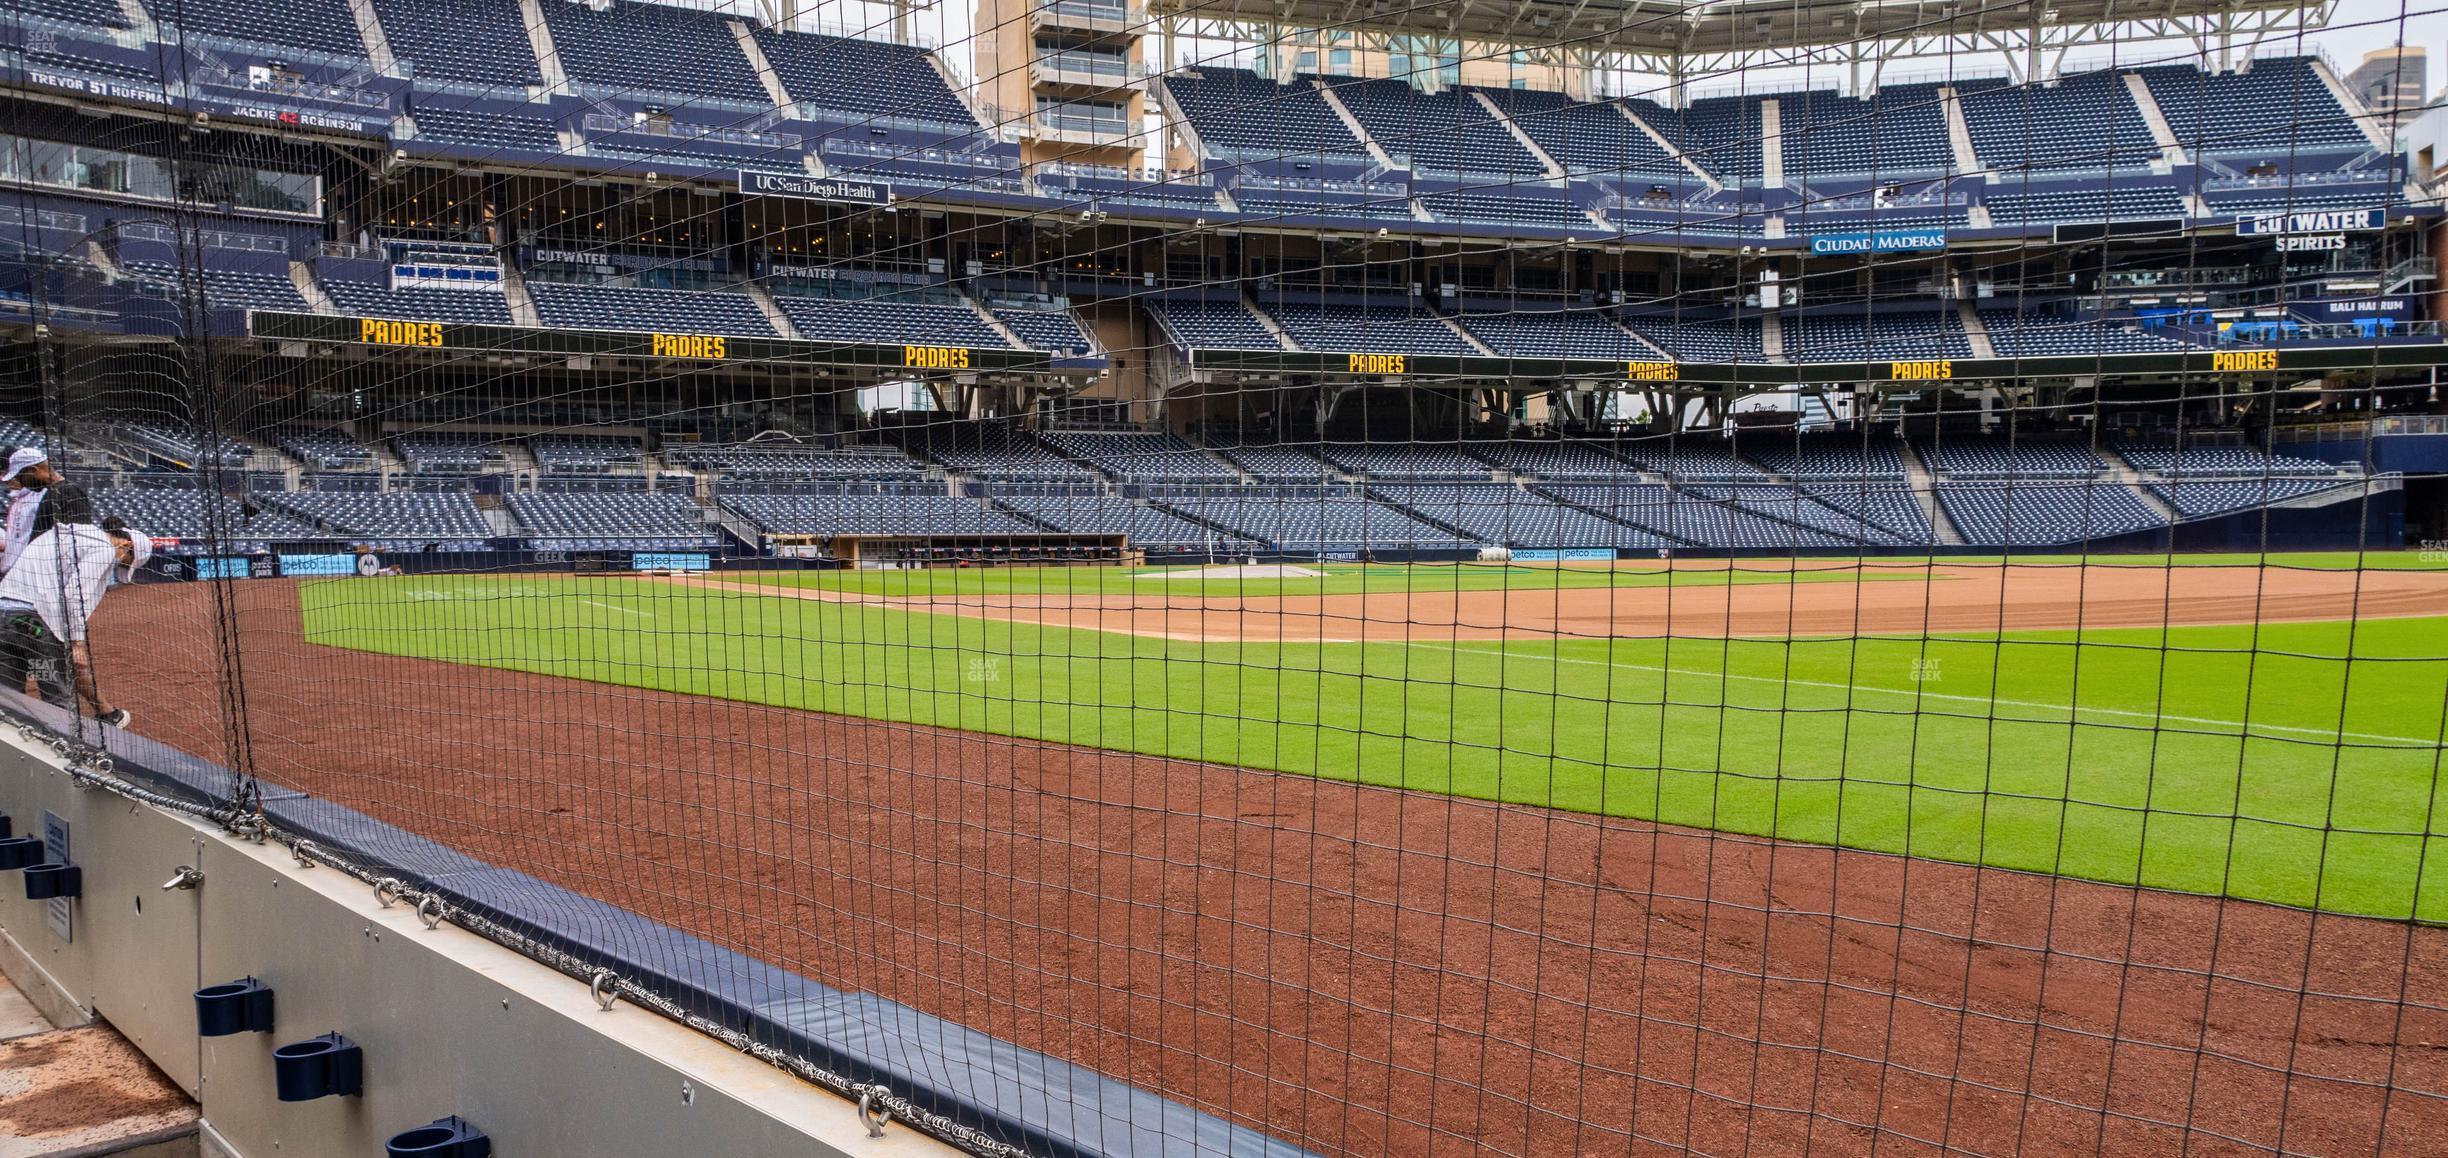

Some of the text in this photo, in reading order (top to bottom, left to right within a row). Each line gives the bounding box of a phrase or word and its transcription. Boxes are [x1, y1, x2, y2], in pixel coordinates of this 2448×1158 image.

[29, 72, 173, 105] TREVOR 51 HOFFMAN
[232, 106, 362, 132] JACKIE 42 ROBINSON
[756, 175, 876, 199] UC San Diego Health
[2253, 210, 2369, 233] CUTWATER
[1815, 235, 1944, 252] CIUDAD MADERAS
[2276, 235, 2346, 251] SPIRITS
[537, 249, 608, 265] CUTWATER
[772, 265, 836, 280] CUTWATER
[2330, 300, 2403, 312] BALI HAI RUM
[362, 319, 443, 346] PADRES
[653, 334, 725, 358] PADRES
[905, 346, 968, 368] PADRES
[1349, 353, 1404, 374] PADRES
[2213, 351, 2278, 371] PADRES
[1628, 361, 1678, 380] PADRES
[1892, 361, 1951, 380] PADRES
[283, 558, 317, 570] petco
[636, 555, 669, 565] petco
